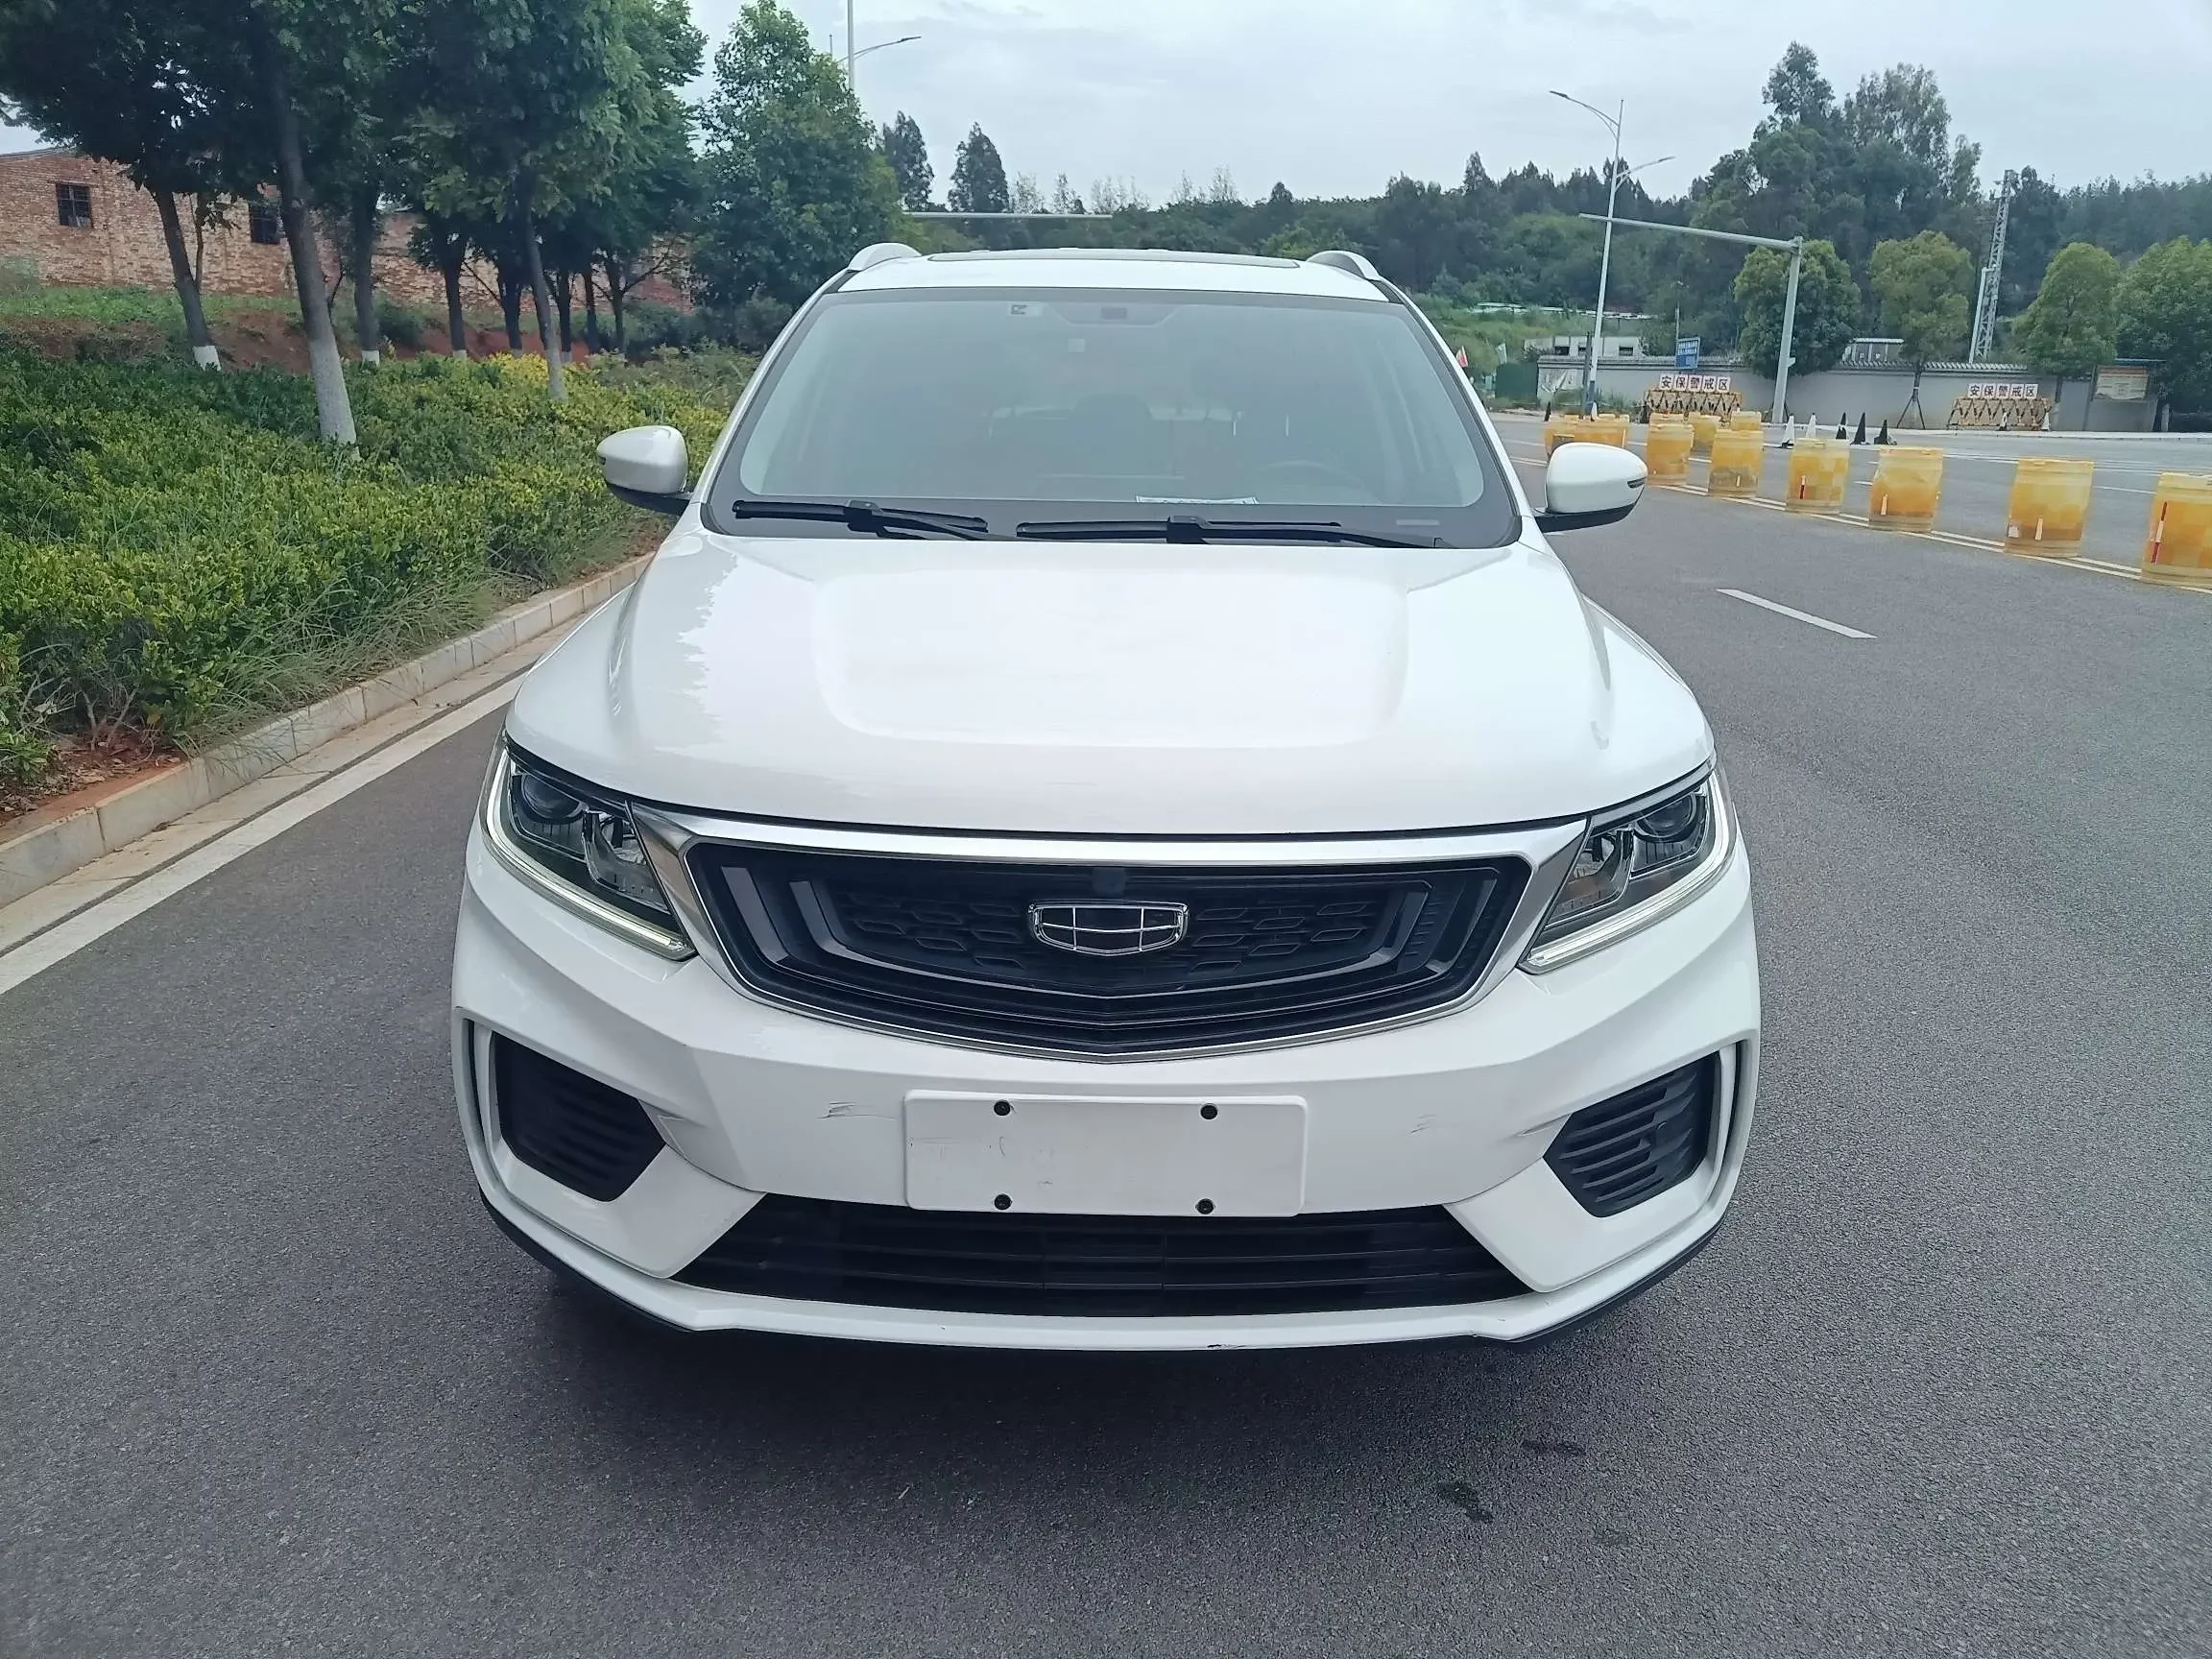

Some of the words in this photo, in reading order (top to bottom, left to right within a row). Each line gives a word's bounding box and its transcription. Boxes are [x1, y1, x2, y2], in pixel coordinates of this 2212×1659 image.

[1661, 375, 1728, 391] 安保警戒区
[1970, 384, 2035, 397] 安保警戒区
